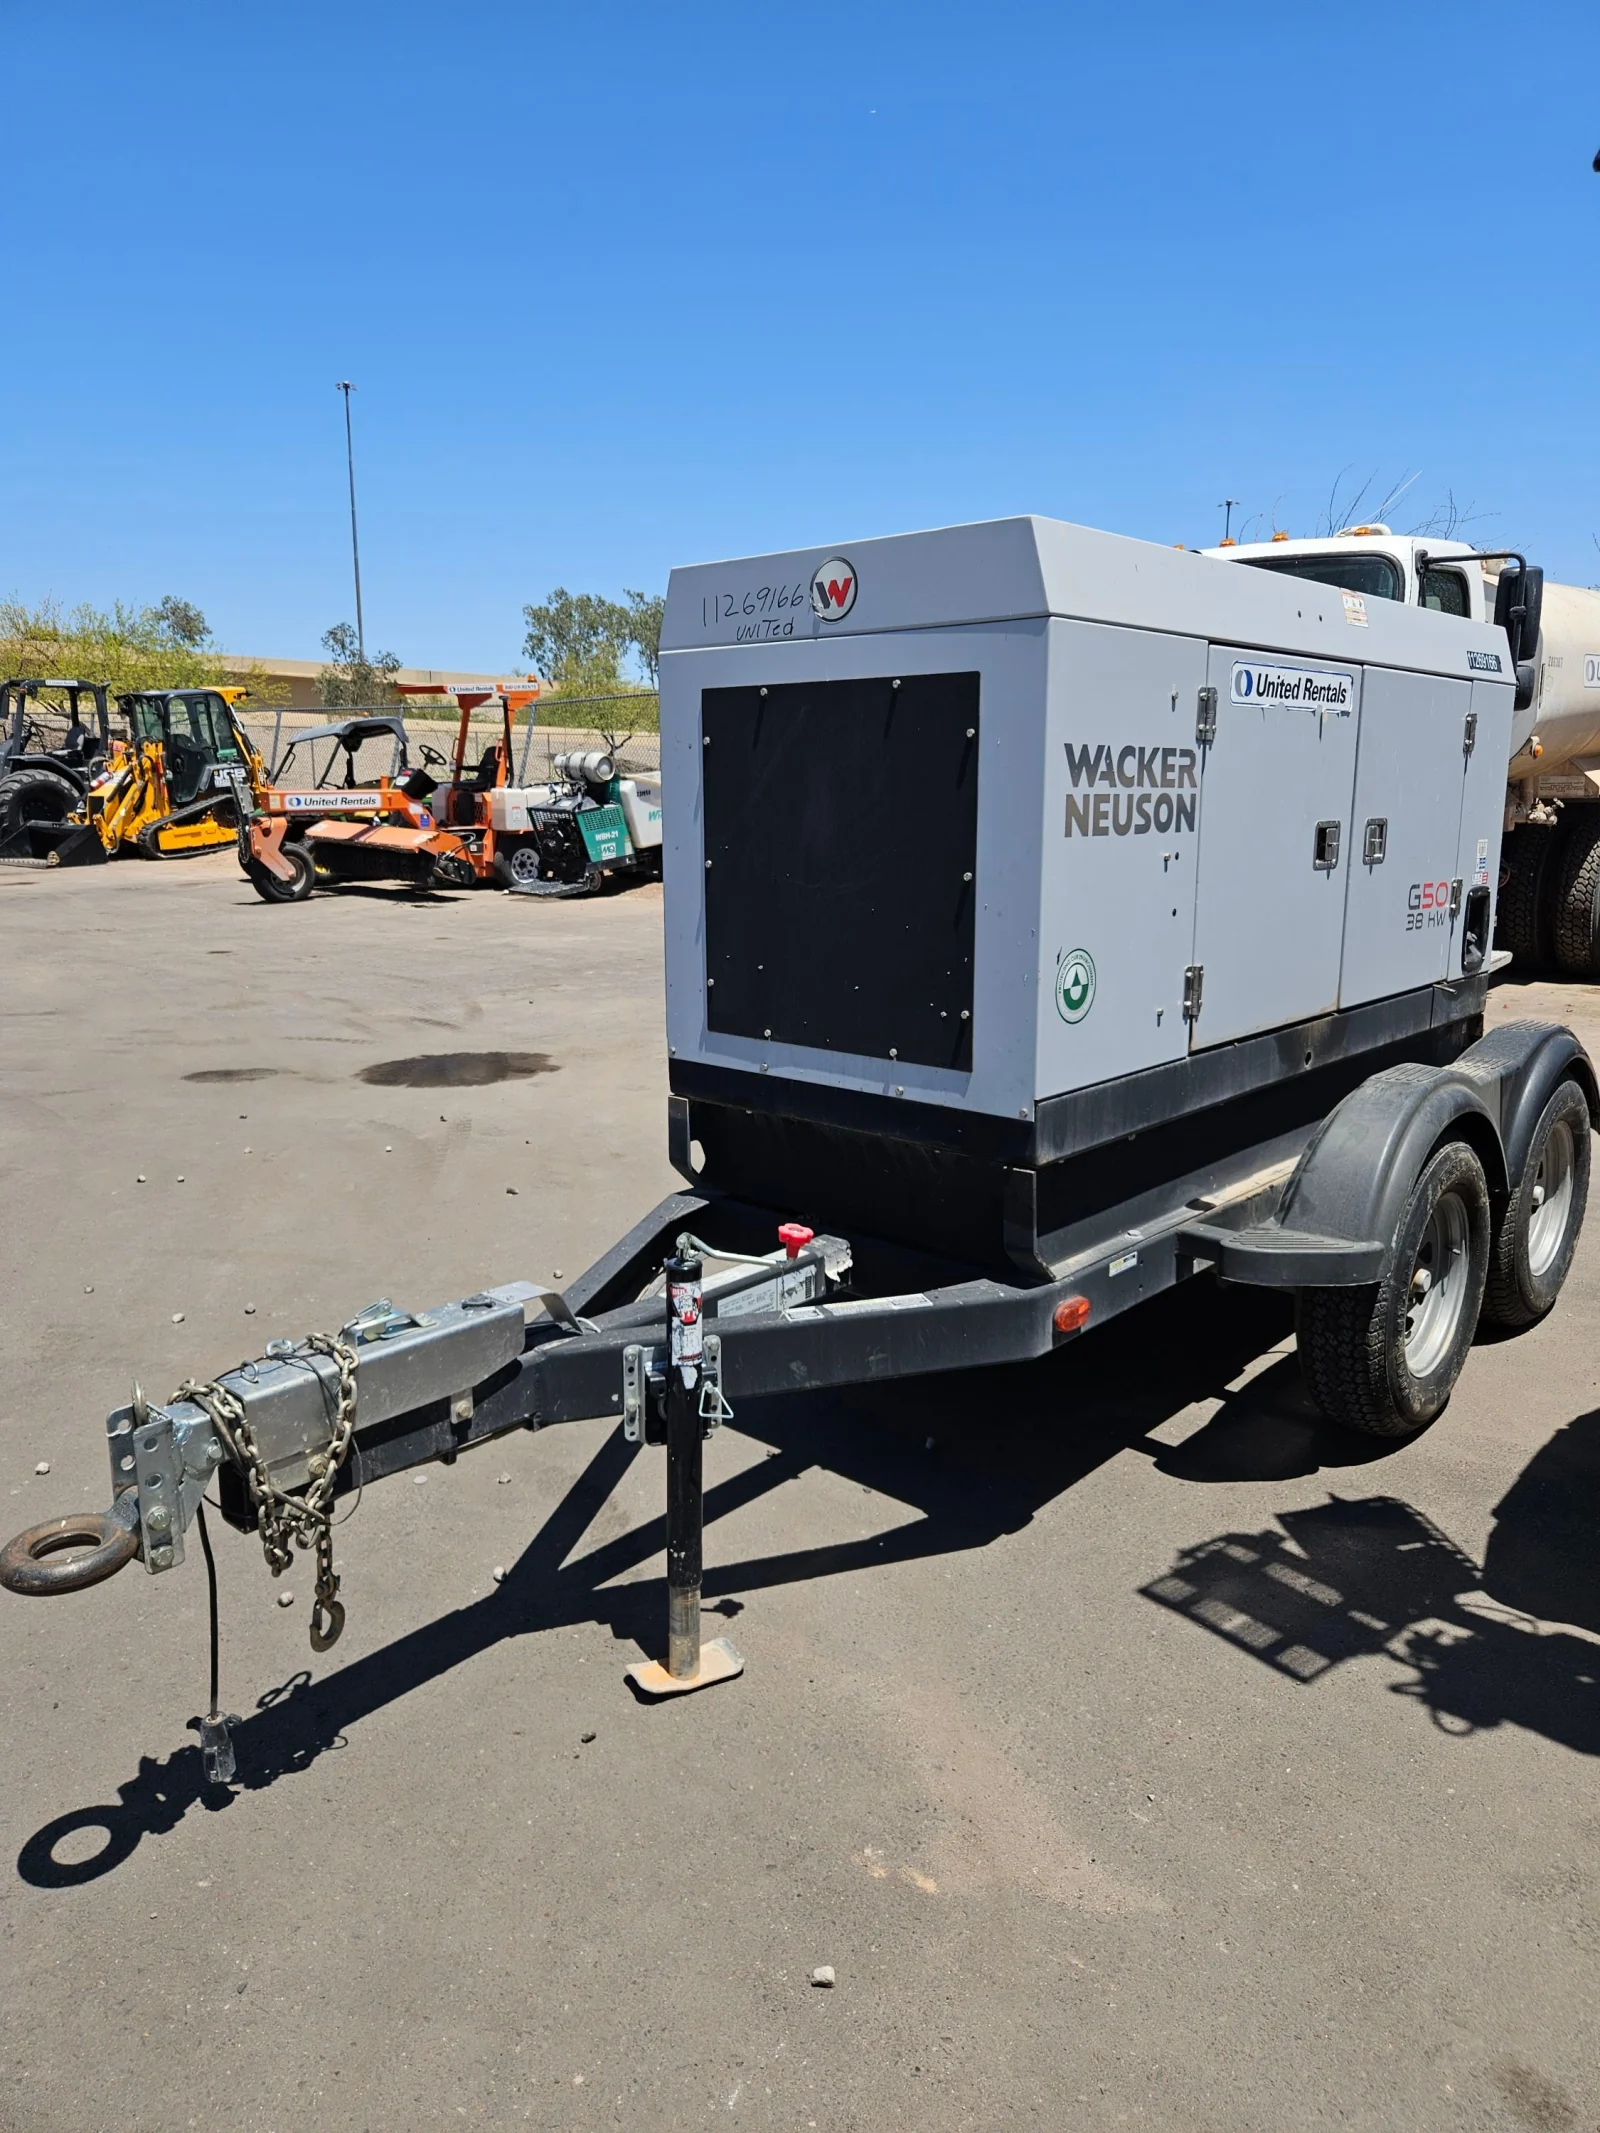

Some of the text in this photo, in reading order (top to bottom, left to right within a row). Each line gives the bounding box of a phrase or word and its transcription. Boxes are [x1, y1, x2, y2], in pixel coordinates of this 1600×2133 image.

[702, 583, 804, 627] 11269166
[1256, 672, 1347, 704] United Rentals
[1064, 743, 1198, 789] WACKER
[304, 796, 376, 807] United Rentals
[1064, 792, 1197, 838] NEUSON
[595, 830, 619, 842] WBH-21
[1408, 881, 1449, 911] G50
[1405, 912, 1424, 931] 38
